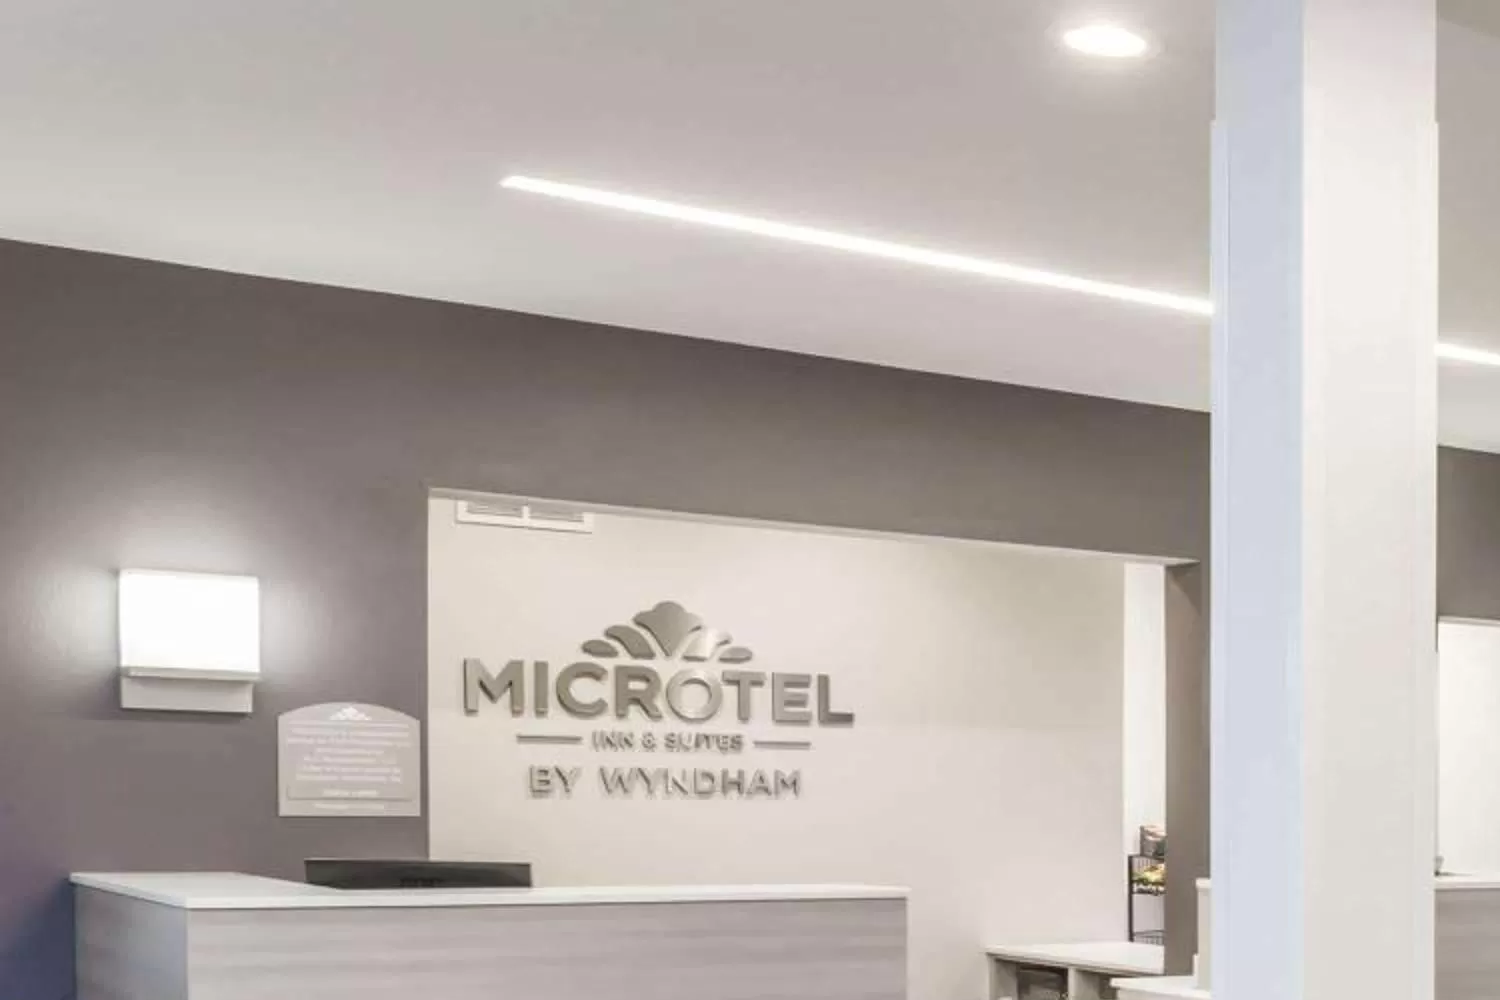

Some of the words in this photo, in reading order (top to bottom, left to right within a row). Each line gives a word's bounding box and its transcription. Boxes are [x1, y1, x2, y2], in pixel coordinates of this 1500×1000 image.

[463, 657, 855, 726] MICROTEL
[591, 730, 634, 749] INN
[641, 731, 657, 750] &
[663, 732, 744, 752] SUITES
[527, 764, 581, 798] BY
[599, 766, 802, 798] WYNDHAM
